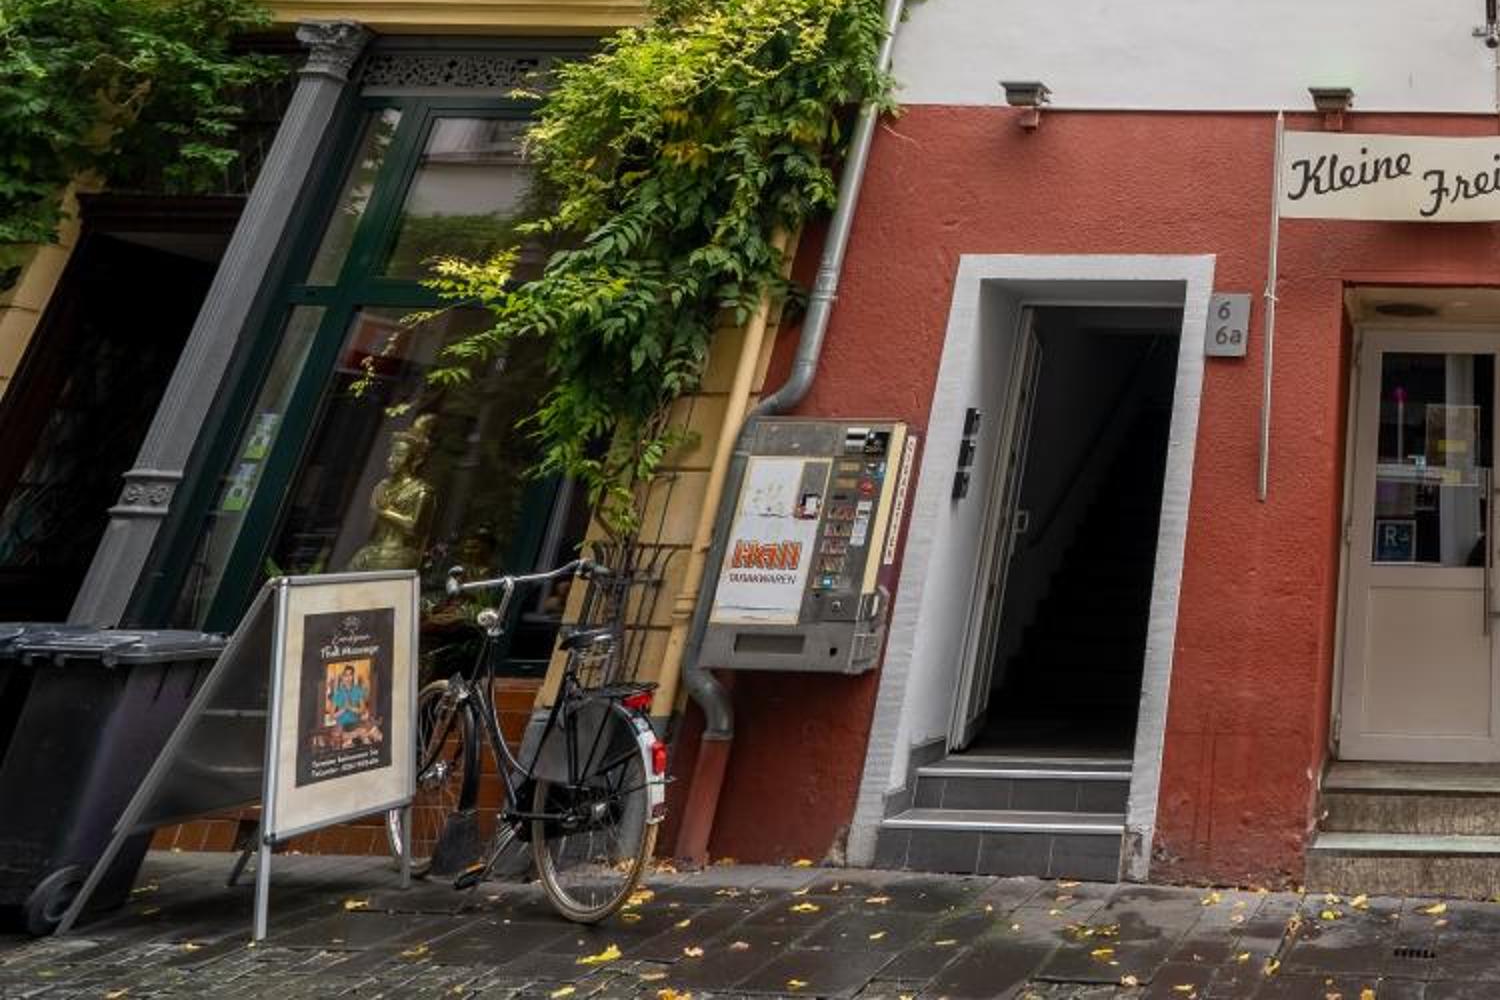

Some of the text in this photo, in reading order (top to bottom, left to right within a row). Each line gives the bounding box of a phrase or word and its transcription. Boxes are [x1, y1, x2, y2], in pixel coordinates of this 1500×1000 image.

[1288, 147, 1412, 201] Kleine
[1217, 301, 1231, 320] 6
[1215, 325, 1242, 345] 6a
